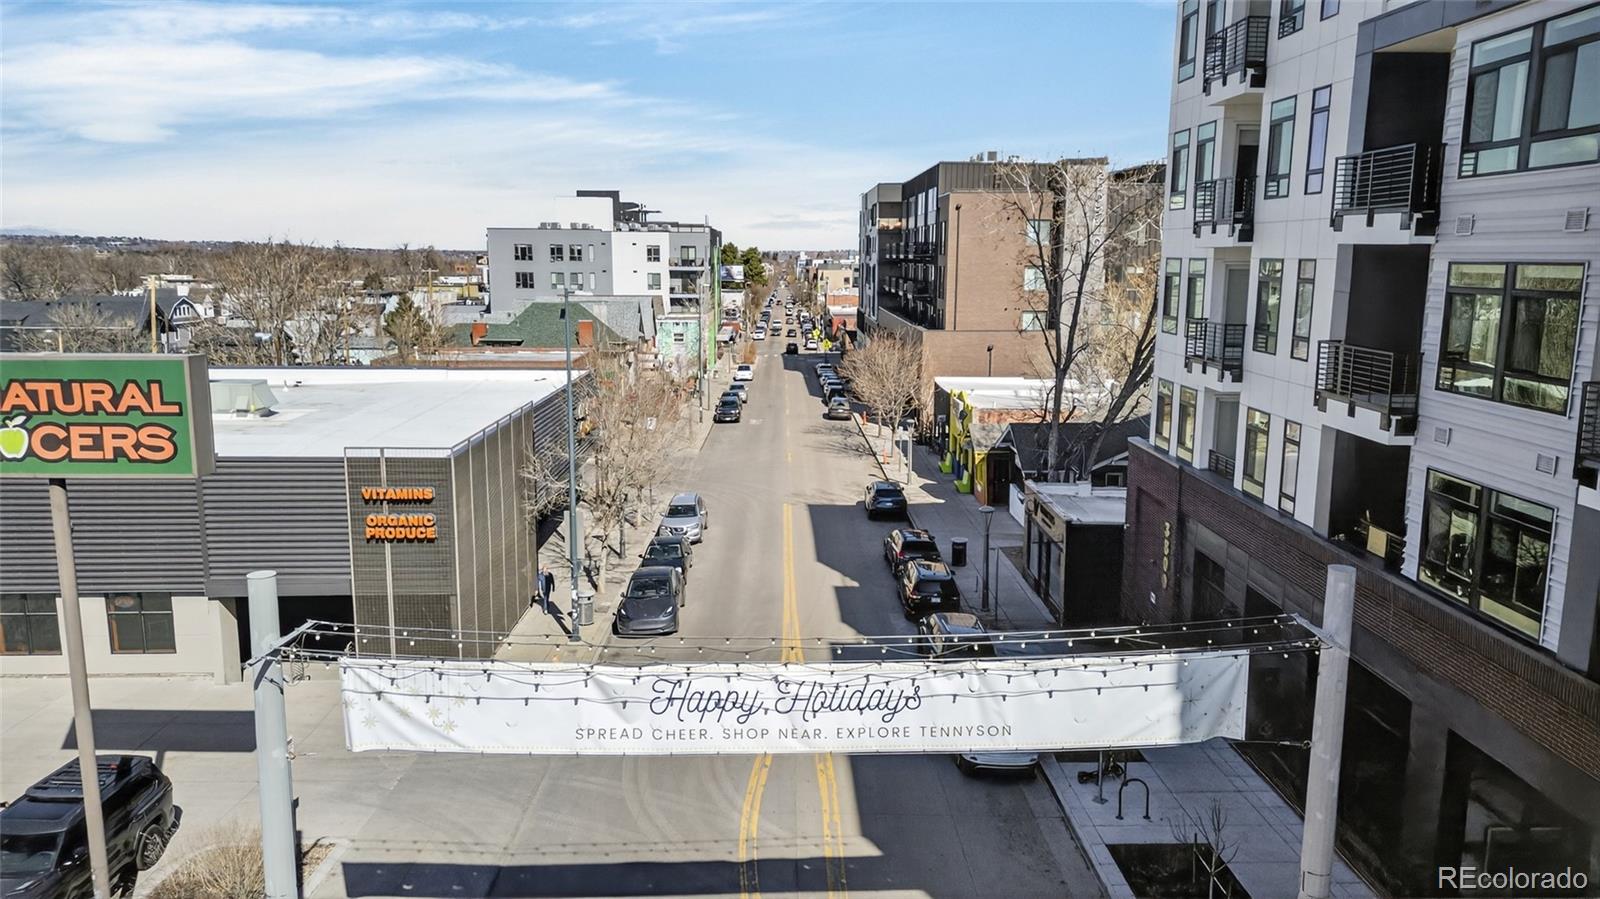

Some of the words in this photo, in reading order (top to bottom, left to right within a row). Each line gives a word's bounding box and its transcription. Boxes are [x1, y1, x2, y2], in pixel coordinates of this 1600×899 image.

[0, 382, 180, 413] ATURAL
[361, 487, 435, 501] VITAMINS
[366, 513, 436, 527] ORGANIC
[365, 527, 437, 540] PRODUCE
[649, 678, 765, 724] Happy
[774, 679, 922, 723] Holidays
[575, 727, 643, 740] SPREAD
[651, 728, 714, 740] CHEER.
[722, 728, 770, 740] SHOP
[778, 728, 828, 740] NEAR.
[836, 726, 911, 739] EXPLORE
[919, 724, 1013, 738] TENNYSON
